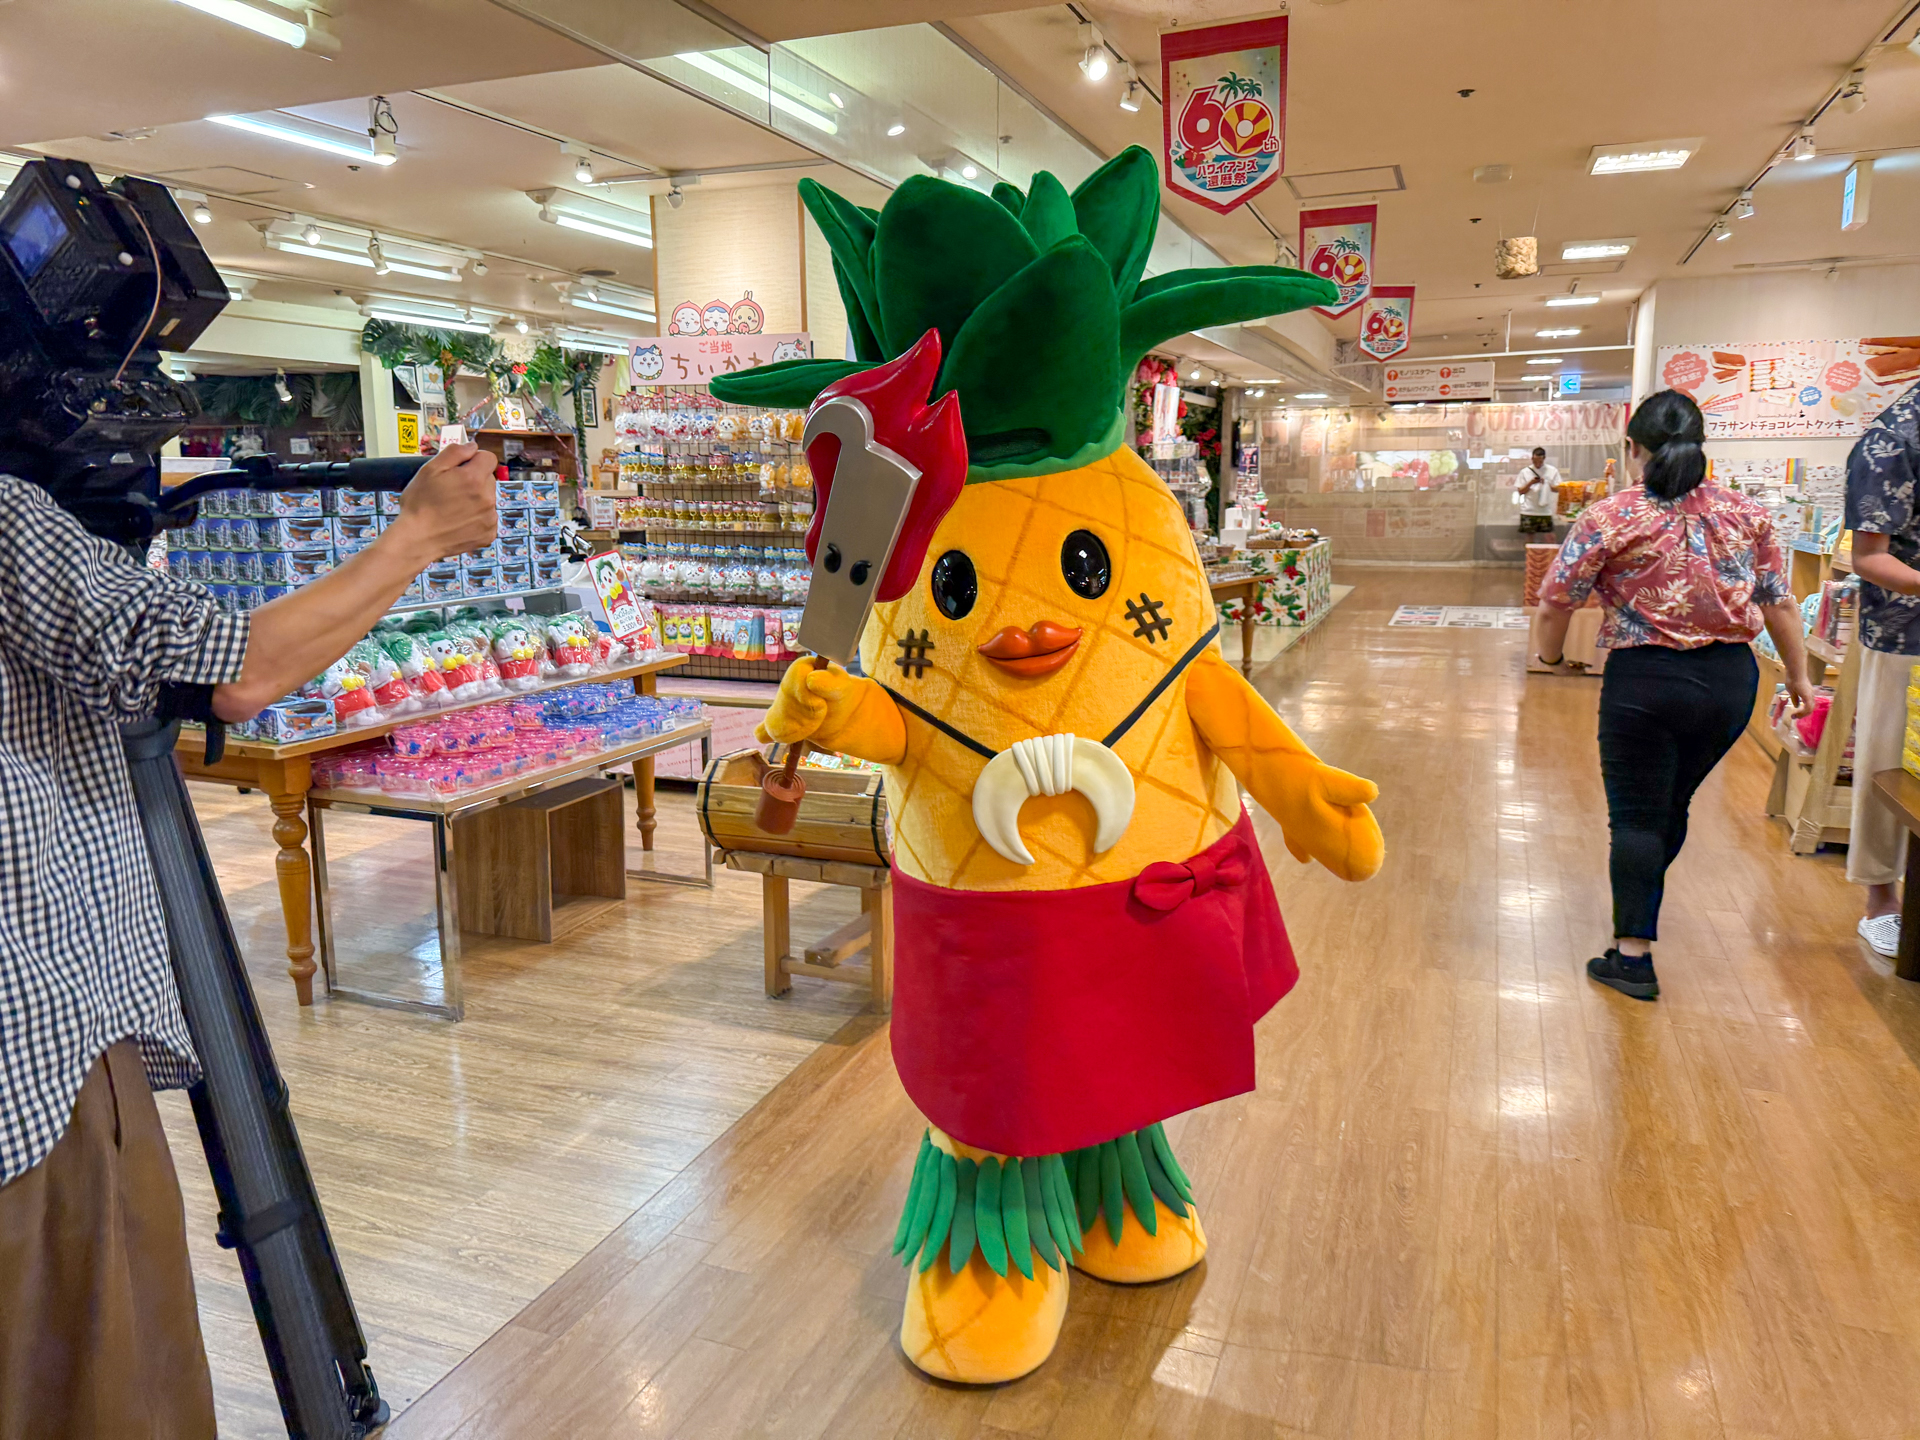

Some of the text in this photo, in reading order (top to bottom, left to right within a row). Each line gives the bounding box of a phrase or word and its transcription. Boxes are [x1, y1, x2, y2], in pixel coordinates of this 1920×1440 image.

[1197, 159, 1258, 177] ハワイアンズ
[1207, 172, 1247, 188] 還暦祭
[699, 340, 733, 354] ご当地
[1708, 420, 1855, 431] フラサンドチョコレートクッキー
[1504, 433, 1601, 442] ICE CANDY
